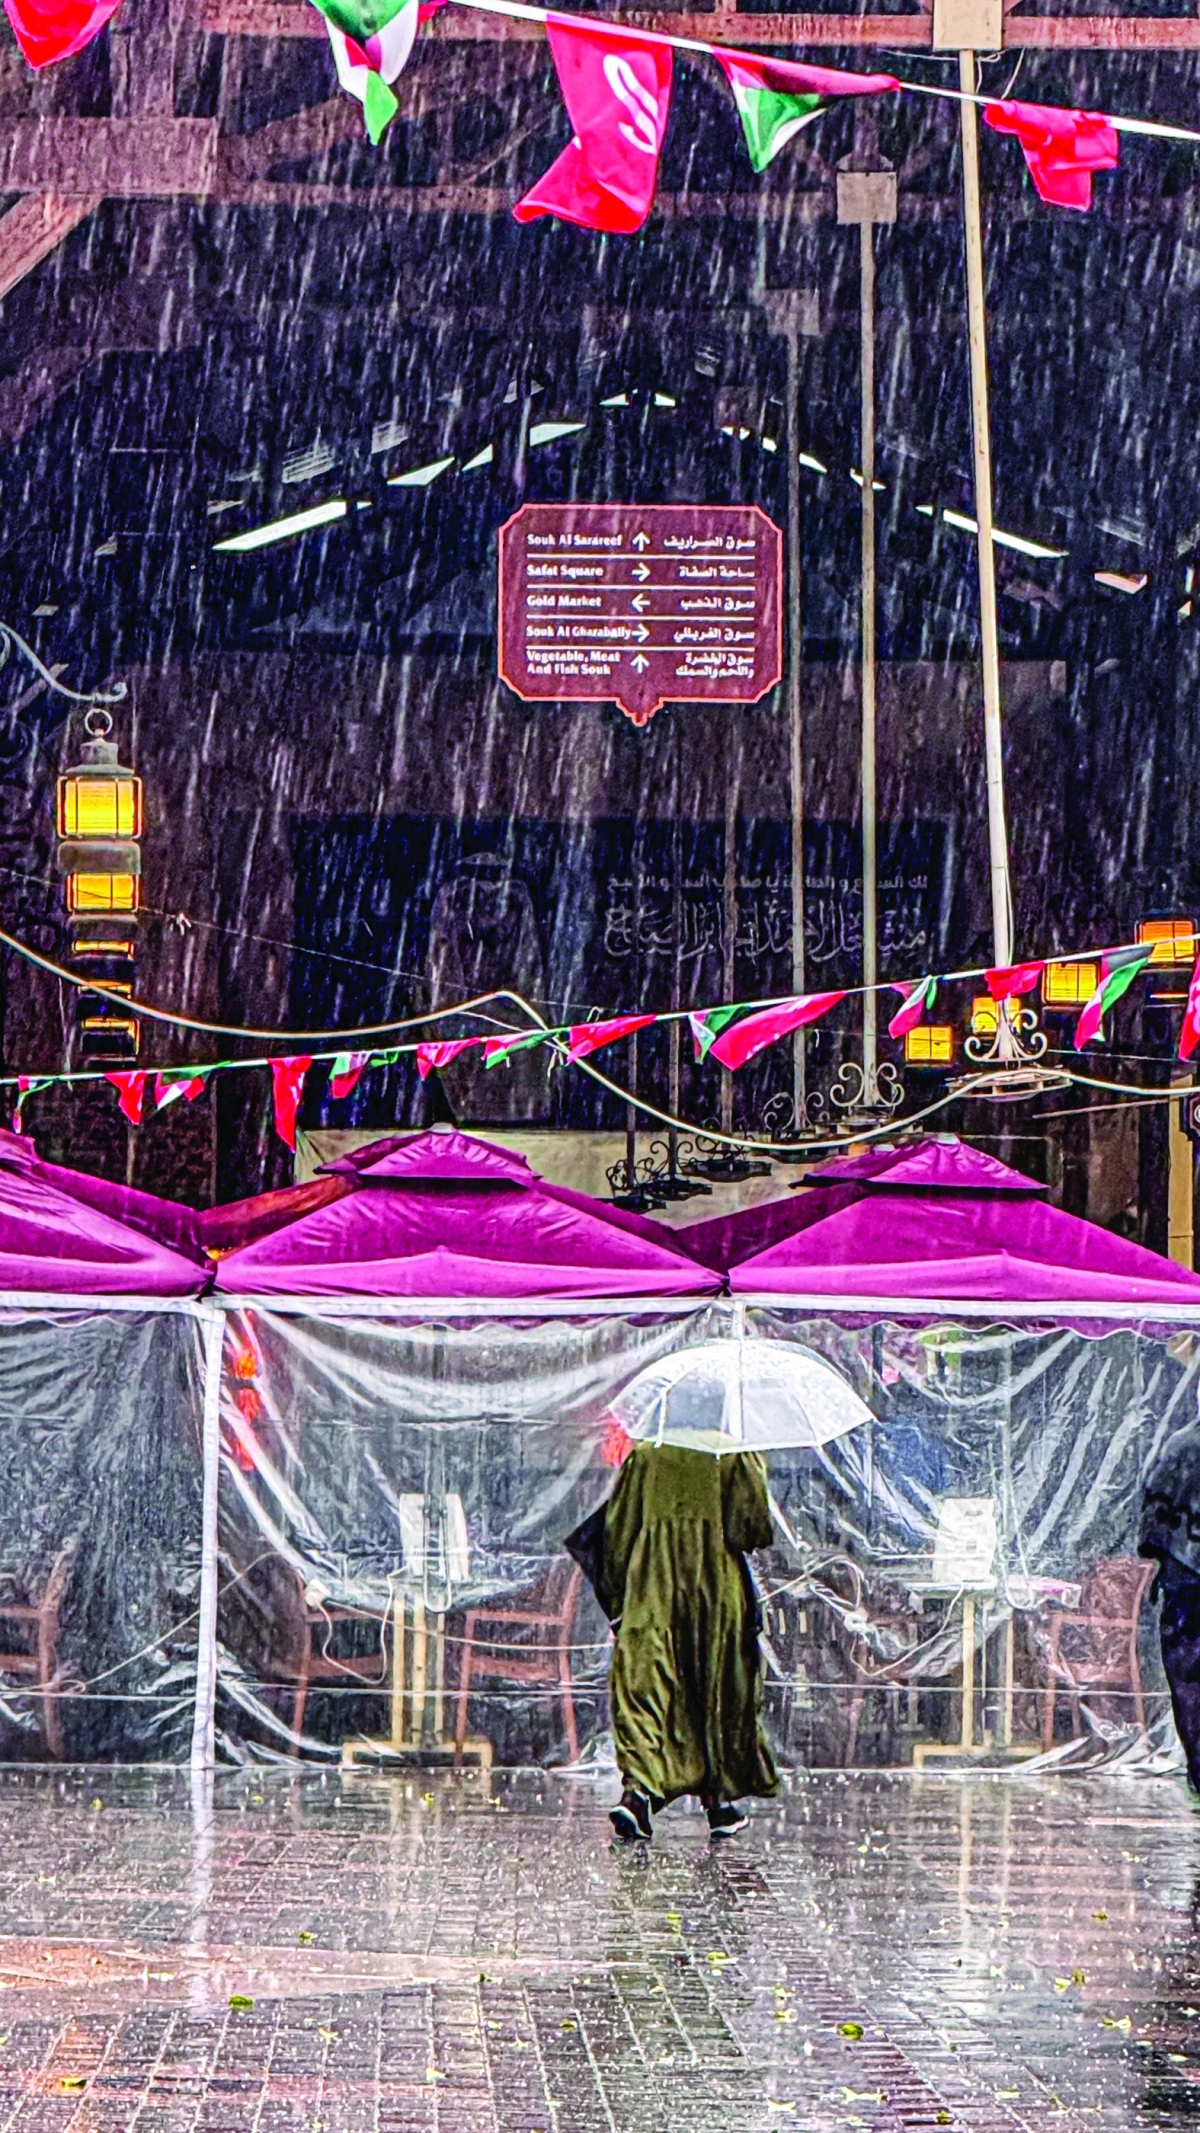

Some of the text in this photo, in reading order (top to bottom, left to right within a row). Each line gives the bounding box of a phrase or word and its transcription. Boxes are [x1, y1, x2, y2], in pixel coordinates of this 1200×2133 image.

[527, 534, 624, 546] Souk Al Sarareef
[725, 536, 756, 551] سوق
[527, 564, 604, 580] Safat Square
[679, 565, 756, 578] ساحة الصفاة
[526, 594, 602, 607] Gold Market
[680, 596, 756, 612] سوق الذهب
[526, 625, 632, 640] Souk Al Gharabally
[723, 627, 756, 642] سوق
[526, 650, 621, 664] Vegetable, Meat
[726, 652, 755, 667] سوق
[527, 663, 611, 675] And Fish Souk
